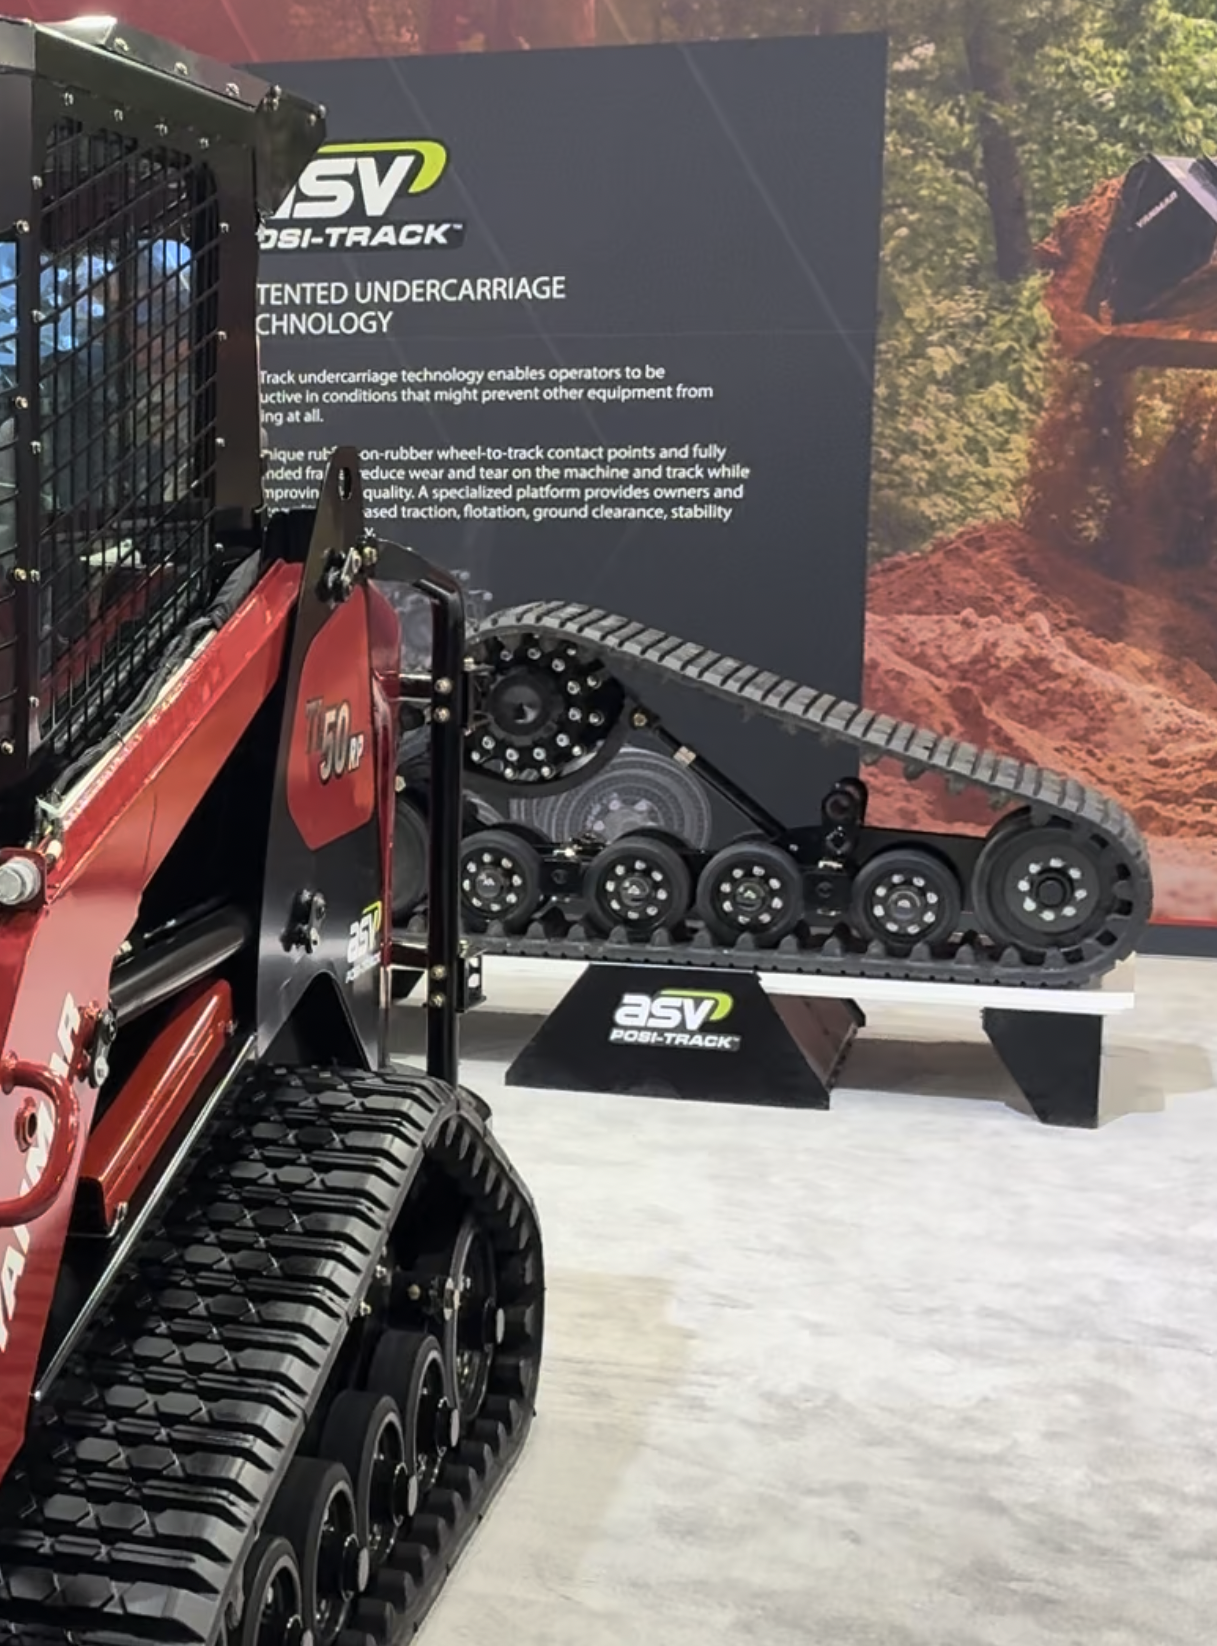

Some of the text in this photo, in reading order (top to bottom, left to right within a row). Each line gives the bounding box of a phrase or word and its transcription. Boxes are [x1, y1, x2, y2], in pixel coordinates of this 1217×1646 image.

[355, 276, 566, 303] UNDERCARRIAGE
[299, 369, 398, 386] undercarriage
[402, 367, 484, 386] technology
[488, 366, 545, 381] enables
[549, 366, 621, 383] operators
[625, 366, 641, 379] to
[645, 364, 665, 379] be
[306, 389, 318, 404] in
[322, 388, 397, 403] conditions
[401, 387, 430, 402] that
[434, 387, 477, 405] might
[481, 386, 539, 404] prevent
[542, 385, 584, 401] other
[587, 384, 672, 402] equipment
[676, 383, 713, 399] from
[286, 410, 300, 423] at
[303, 408, 324, 423] all.
[436, 444, 544, 460] wheel-to-track
[547, 445, 603, 460] contact
[607, 445, 655, 463] points
[659, 443, 688, 459] and
[692, 443, 726, 462] fully
[409, 468, 444, 480] wear
[448, 465, 475, 480] and
[479, 467, 508, 480] tear
[512, 466, 531, 480] on
[535, 464, 561, 480] the
[564, 463, 629, 480] machine
[633, 463, 662, 479] and
[666, 463, 704, 479] track
[708, 463, 750, 479] while
[363, 484, 415, 502] quality.
[418, 485, 429, 499] A
[432, 484, 512, 502] specialized
[516, 483, 580, 501] platform
[584, 483, 649, 501] provides
[653, 486, 710, 499] owners
[713, 483, 743, 499] and
[401, 503, 460, 520] traction,
[464, 502, 530, 520] flotation,
[533, 504, 588, 522] ground
[591, 504, 668, 520] clearance,
[671, 504, 732, 522] stability
